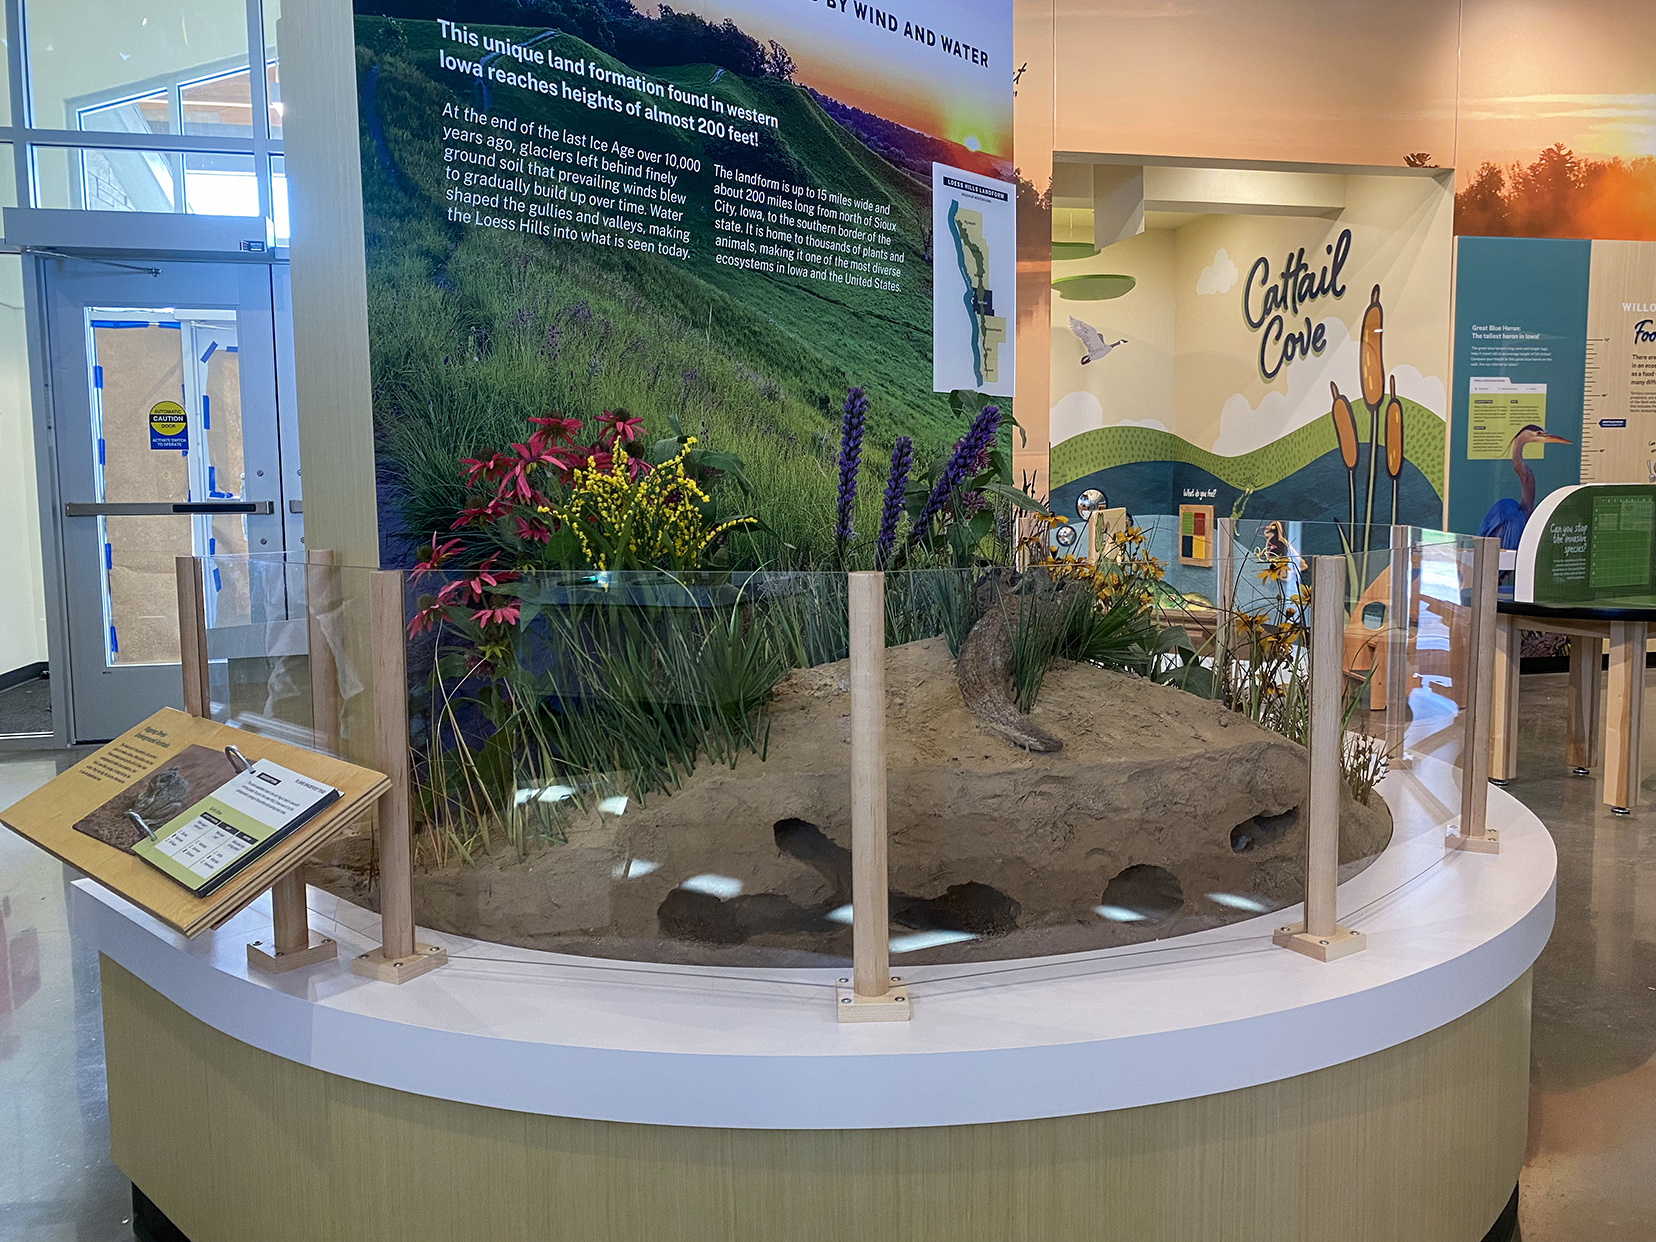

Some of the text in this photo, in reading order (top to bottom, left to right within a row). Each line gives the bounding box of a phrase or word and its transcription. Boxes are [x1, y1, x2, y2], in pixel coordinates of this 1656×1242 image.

[853, 0, 898, 32] WIND
[903, 21, 936, 47] AND
[940, 34, 989, 68] WATER
[436, 18, 778, 128] This unique land formation found in western
[439, 49, 759, 147] Iowa reaches heights of almost 200 feet!
[442, 102, 701, 172] At the end of the last Ice Age over 10,000
[442, 126, 678, 188] years ago, glaciers left behind finely
[443, 147, 687, 204] ground soil that prevailing winds blew
[446, 166, 683, 222] to gradually build up over time. Water
[713, 163, 891, 216] The landform is up to 15 miles wide and
[948, 179, 964, 188] LOESS
[964, 184, 978, 192] HILLS
[979, 187, 1005, 199] LANDFORM
[446, 186, 691, 244] shaped the gullies and valleys, making
[447, 207, 691, 261] the Loess Hills into what is seen today.
[713, 183, 897, 232] about 200 miles long from north of Sioux
[714, 199, 891, 246] City, Iowa, to the southern border of the
[714, 218, 905, 264] state. It is home to thousands of plants and
[715, 236, 901, 277] animals, making it one of the most diverse
[715, 254, 902, 293] ecosystems in Iowa and the United States.
[1243, 228, 1352, 330] Cattail
[1259, 314, 1327, 380] Cove
[1550, 522, 1588, 537] Can you stop
[1553, 534, 1587, 544] the invasive
[1564, 543, 1587, 556] species?
